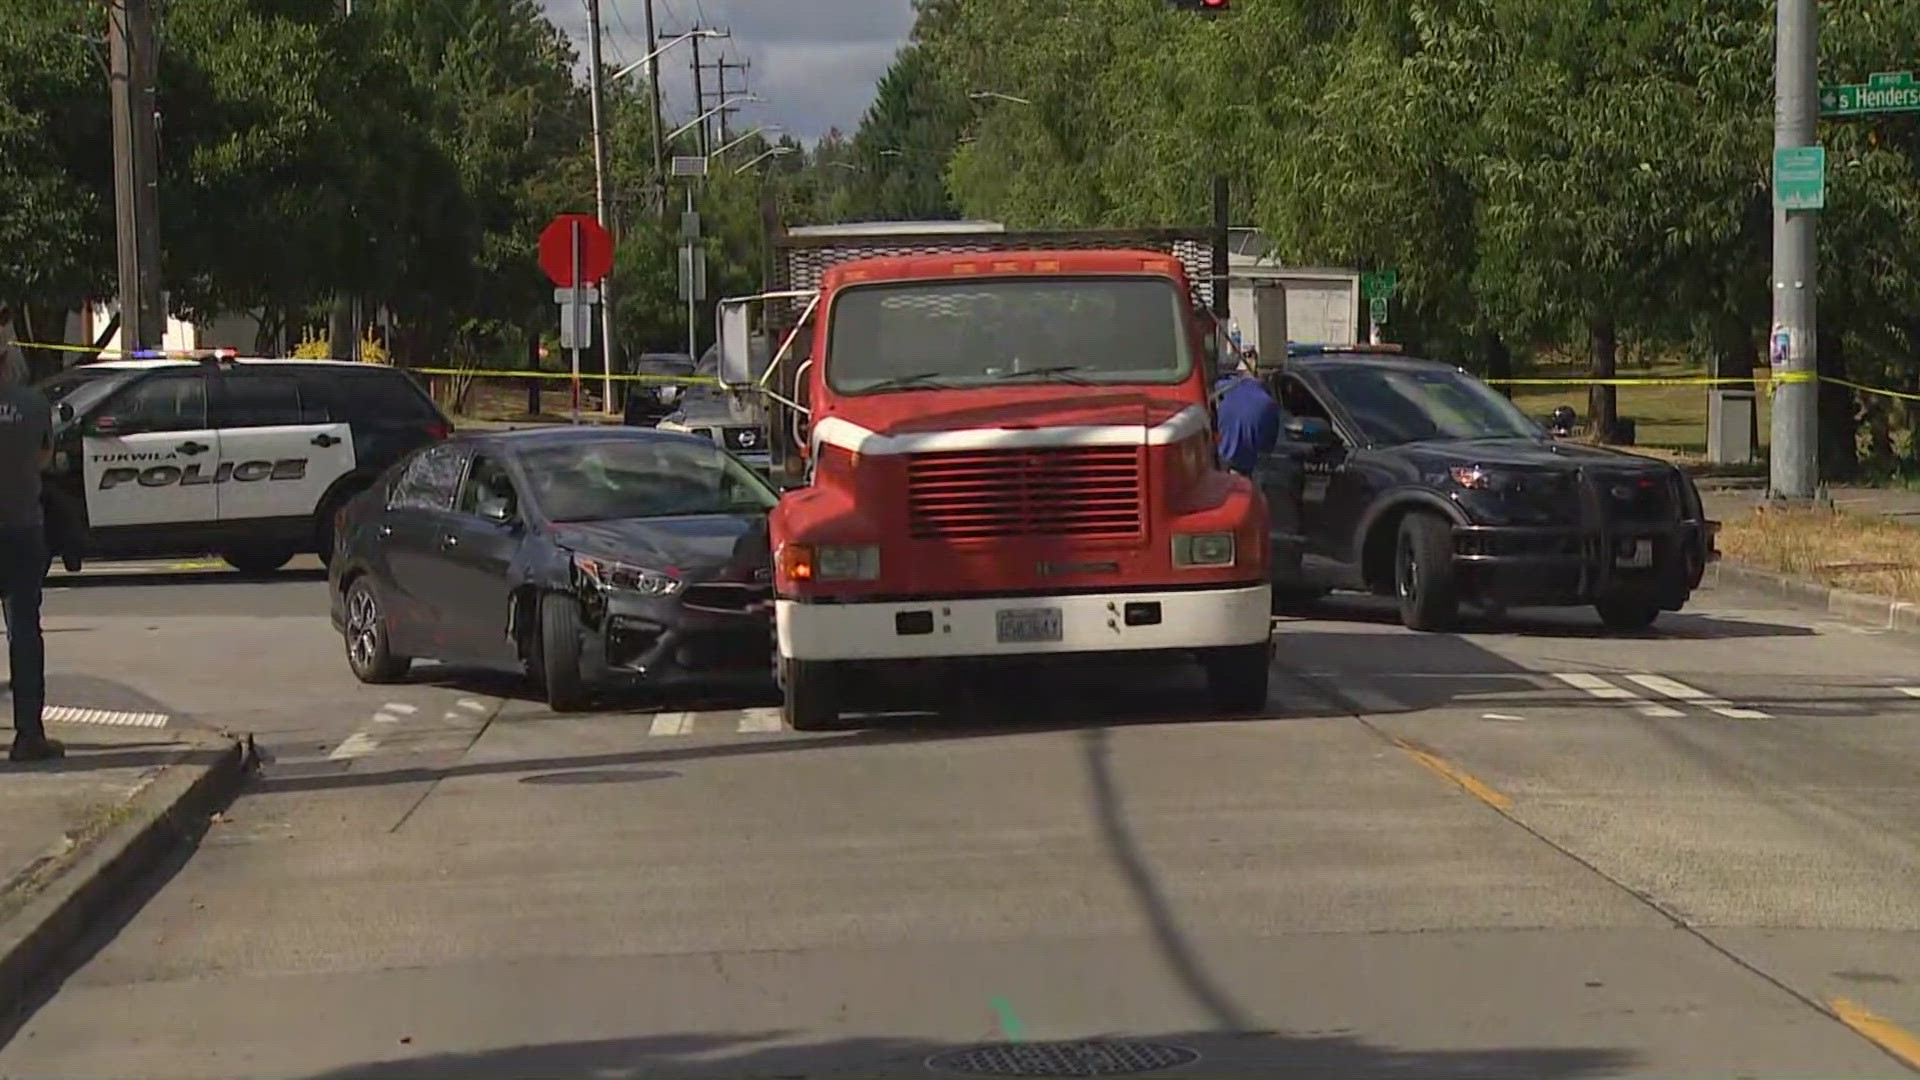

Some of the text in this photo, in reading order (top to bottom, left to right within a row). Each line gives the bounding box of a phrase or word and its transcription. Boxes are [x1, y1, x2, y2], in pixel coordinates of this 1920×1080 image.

[92, 452, 177, 463] TUKWILA
[1303, 461, 1345, 473] WILA
[99, 458, 308, 490] POLICE
